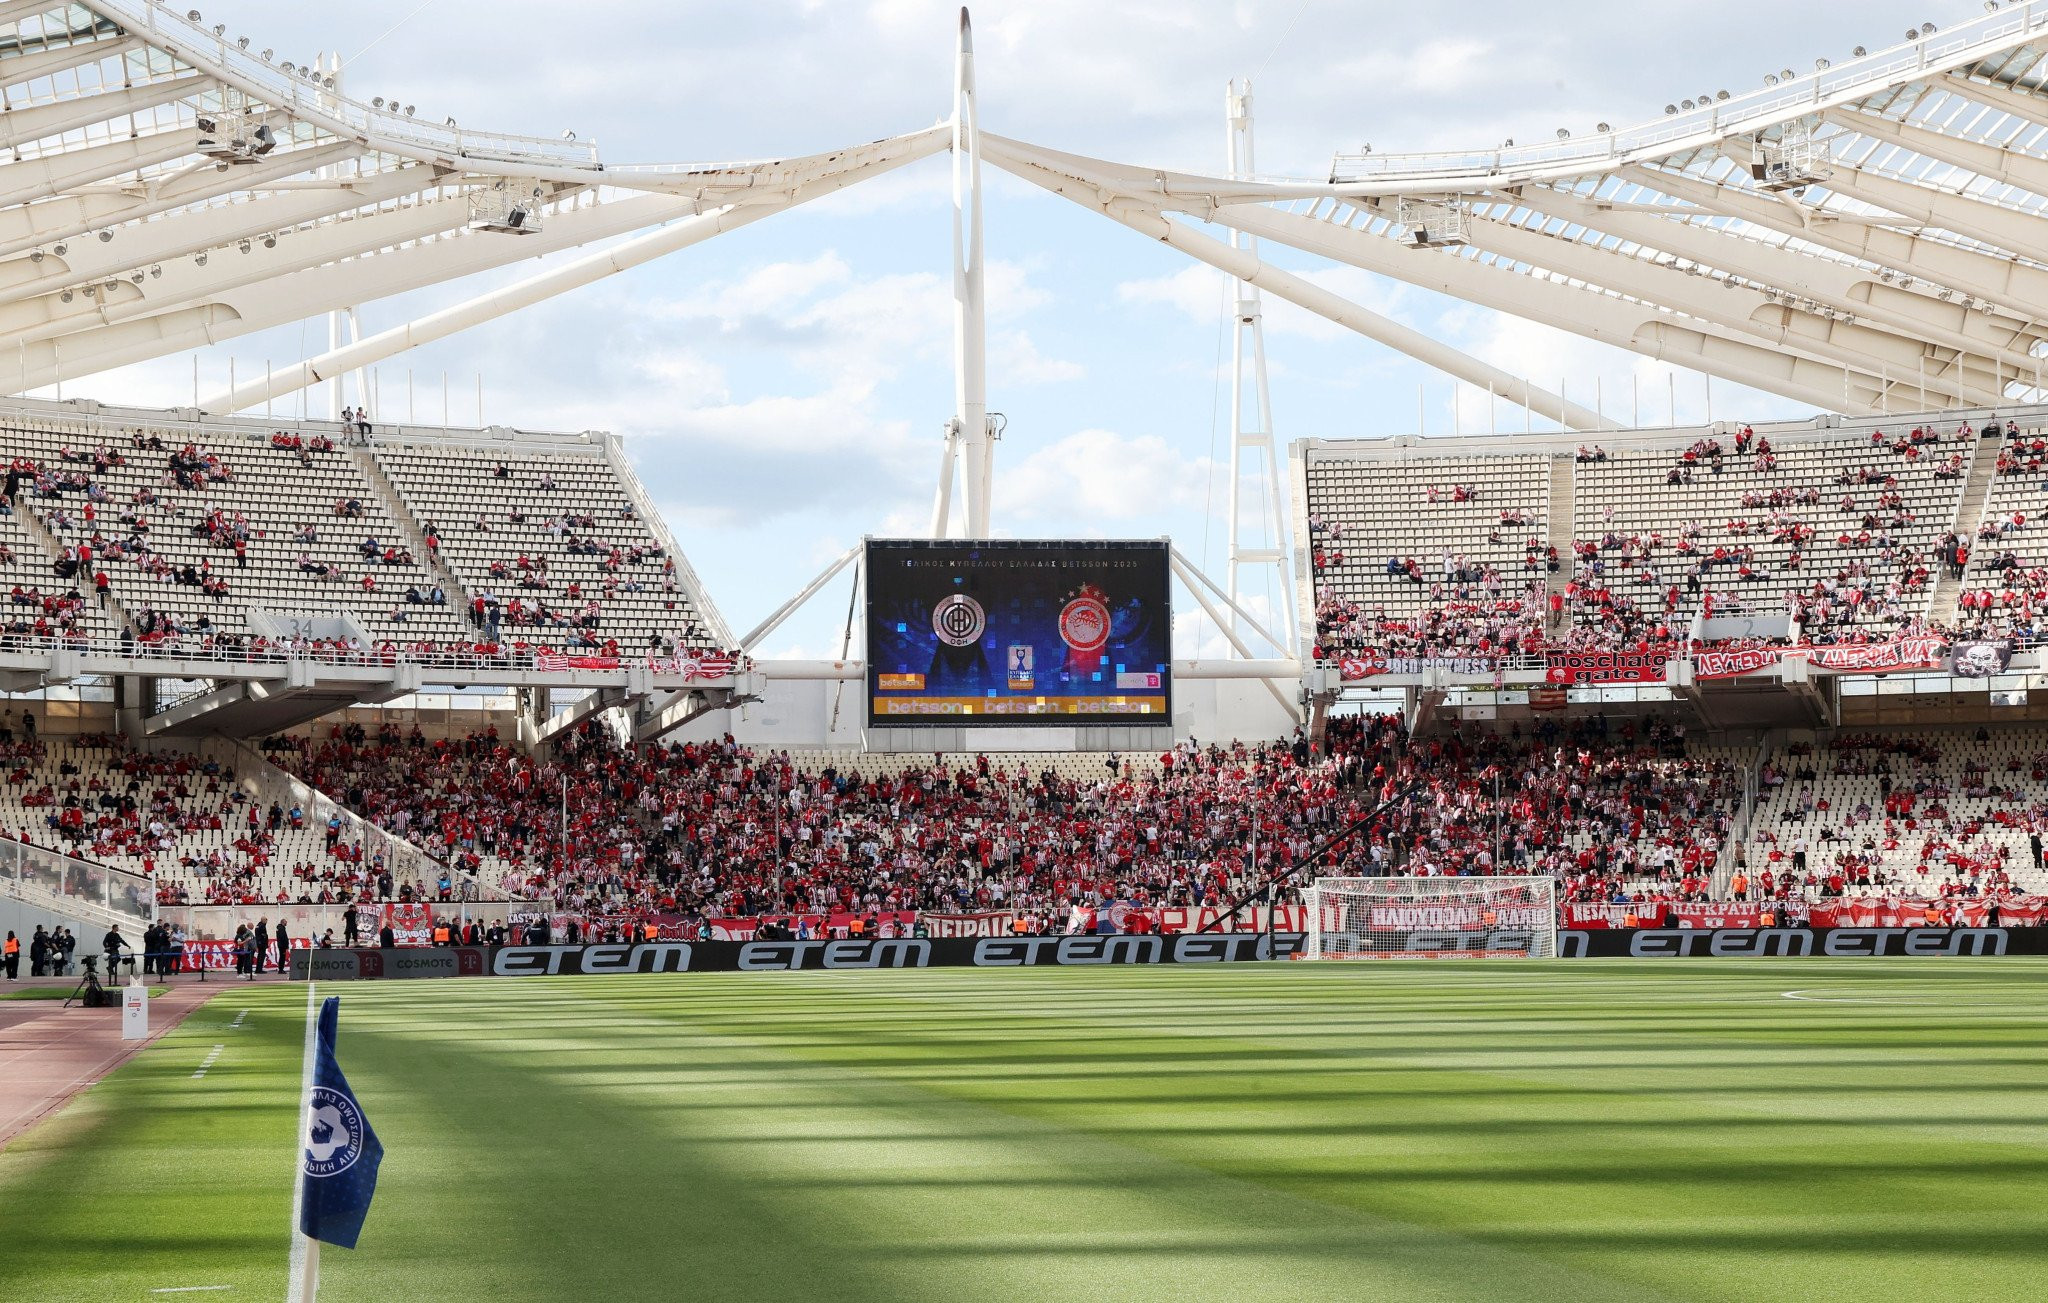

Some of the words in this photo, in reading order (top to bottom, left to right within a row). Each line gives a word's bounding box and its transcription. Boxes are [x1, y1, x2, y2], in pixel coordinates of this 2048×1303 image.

[901, 560, 945, 568] ΤΕΛΙΚΟΣ
[949, 560, 1005, 568] ΚΥΠΕΛΛΟΥ
[1009, 560, 1057, 568] ΕΛΛΑΔΑΣ
[1062, 560, 1109, 568] BETSSON
[1113, 560, 1138, 568] 2025
[290, 618, 313, 638] 34
[1743, 618, 1756, 637] 2
[1547, 652, 1668, 669] moschato
[880, 678, 920, 687] betsson
[1574, 668, 1641, 683] gate
[887, 700, 964, 714] betsson
[983, 700, 1059, 714] betsson
[1077, 700, 1150, 714] betsson
[1630, 929, 1814, 957] ETEM
[1824, 928, 2009, 956] ETEM
[494, 944, 692, 975] ETEM
[738, 942, 932, 970] ETEM
[974, 937, 1162, 967] ETEM
[296, 961, 354, 971] COSMOTE
[397, 959, 453, 969] COSMOTE
